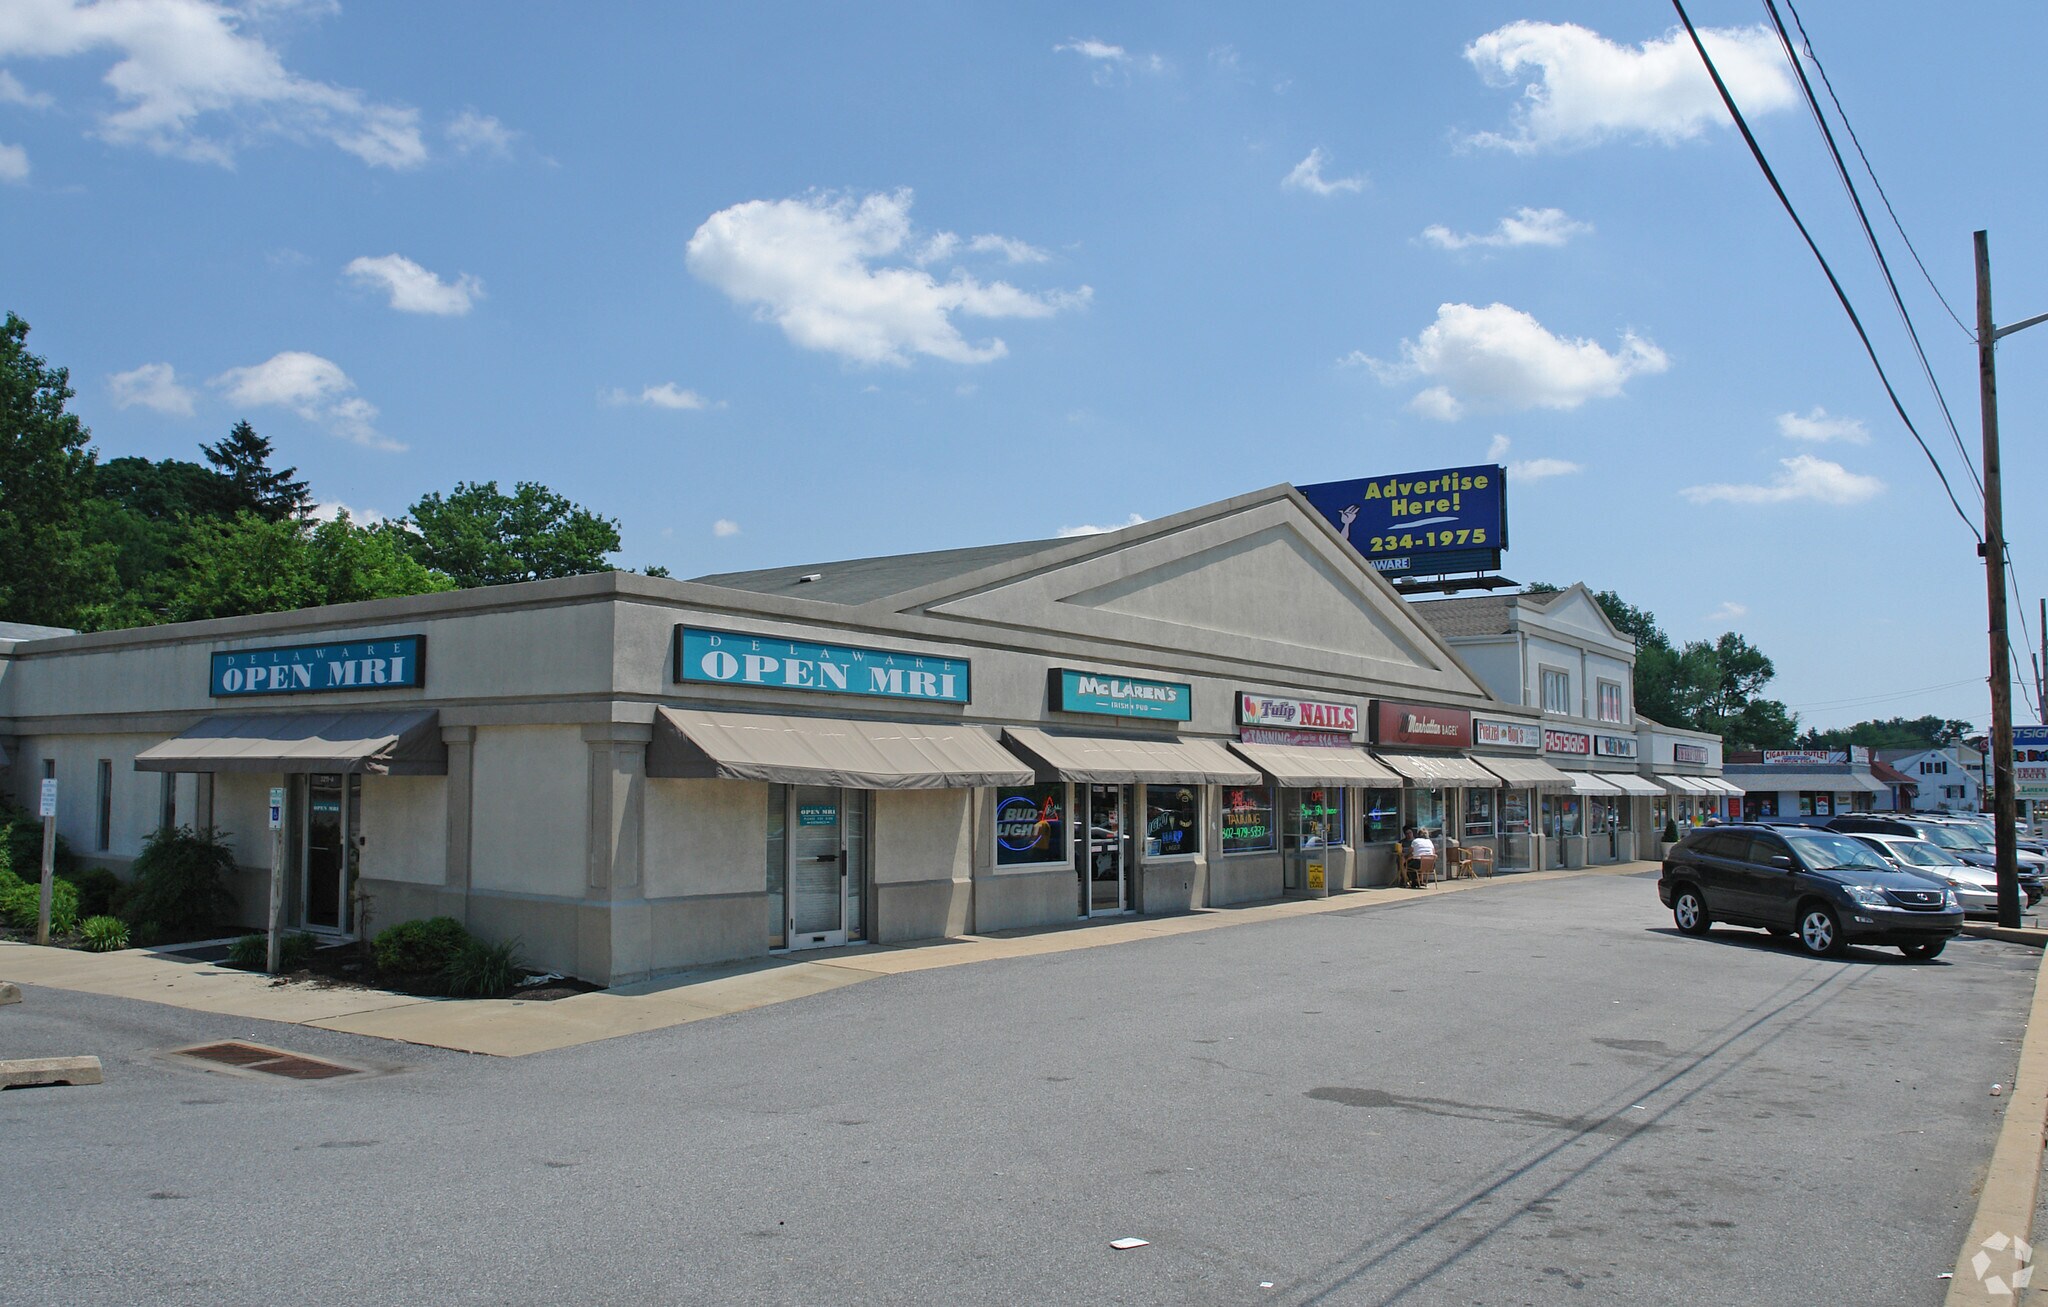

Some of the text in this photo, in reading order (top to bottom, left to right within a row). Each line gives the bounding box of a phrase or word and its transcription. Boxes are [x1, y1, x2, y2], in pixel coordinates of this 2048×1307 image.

[1365, 472, 1488, 500] Advertise
[1391, 493, 1460, 516] Here!
[1370, 529, 1486, 552] 234-1975
[228, 643, 400, 666] DELAWARE
[710, 635, 951, 671] DELAWARE
[222, 656, 405, 692] OPEN MRI
[701, 650, 957, 698] OPEN MRI
[1111, 701, 1148, 711] IRISH PUB
[1261, 700, 1355, 729] Tulip NAILS
[1407, 714, 1458, 736] Manhattan BAGEL
[1249, 730, 1290, 746] TANNING
[1545, 731, 1585, 753] FASTSIGNS
[1765, 751, 1800, 760] CIGARETTE
[1803, 751, 1828, 760] OUTLET
[1004, 808, 1037, 820] BUD
[997, 823, 1042, 836] LIGHT
[1162, 830, 1183, 843] HARP
